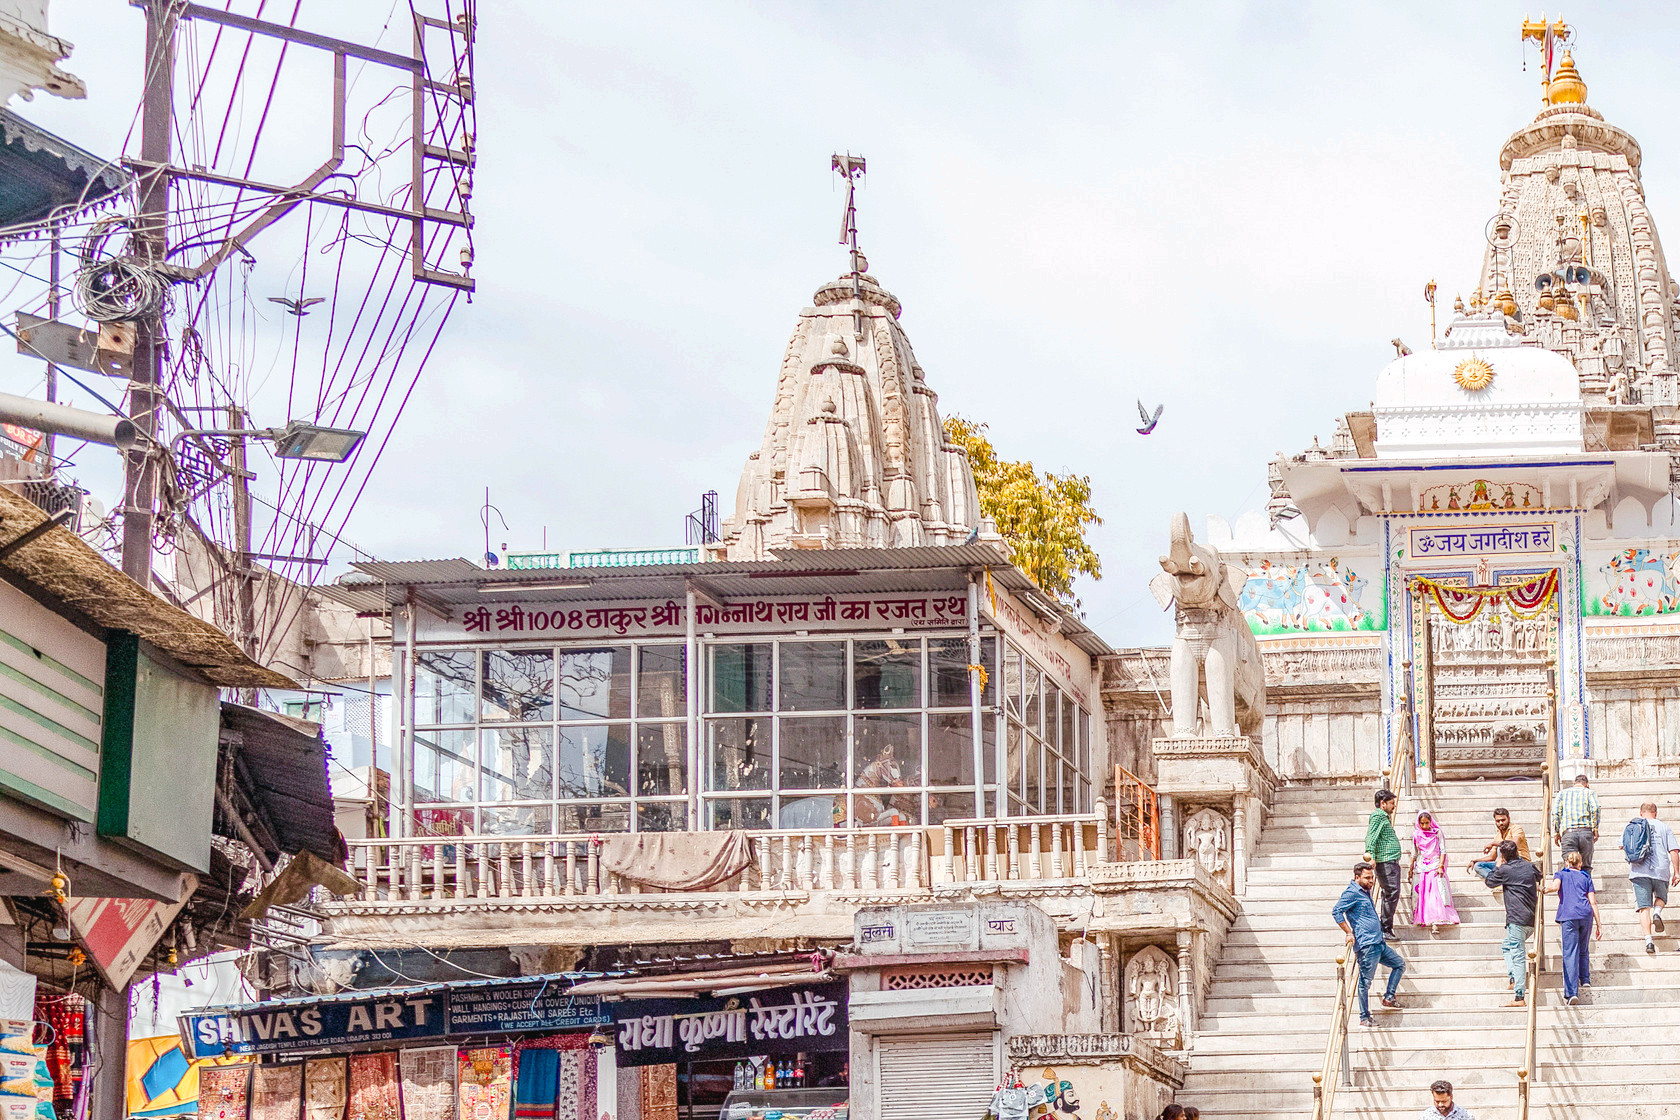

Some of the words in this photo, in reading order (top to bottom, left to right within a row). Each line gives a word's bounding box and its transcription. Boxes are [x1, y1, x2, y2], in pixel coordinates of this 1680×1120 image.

[1434, 534, 1467, 552] जय
[1469, 528, 1529, 550] जगदीश
[1531, 527, 1550, 548] हरे
[463, 606, 492, 632] श्री
[495, 605, 525, 631] श्री
[527, 610, 583, 630] 1008
[586, 607, 647, 634] ठाकुर
[650, 601, 682, 626] श्री
[776, 602, 809, 623] राय
[813, 596, 837, 621] जी
[839, 601, 871, 620] का
[874, 599, 927, 621] रजत
[932, 596, 967, 618] रथ
[861, 920, 894, 942] तुलसी
[493, 989, 523, 1000] WOOLEN
[451, 1013, 493, 1024] GARMENTS
[547, 1008, 577, 1018] SAREES
[579, 1007, 594, 1017] Etc
[452, 1004, 471, 1013] WALL
[472, 1001, 508, 1012] HANGINGS
[198, 1005, 322, 1045] SHIVA'S
[347, 998, 433, 1032] ART
[500, 1021, 514, 1030] (WE
[516, 1020, 539, 1028] ACCEPT
[555, 1017, 581, 1026] CREDIT
[583, 1015, 611, 1024] CARDS)
[618, 1014, 674, 1051] राधा
